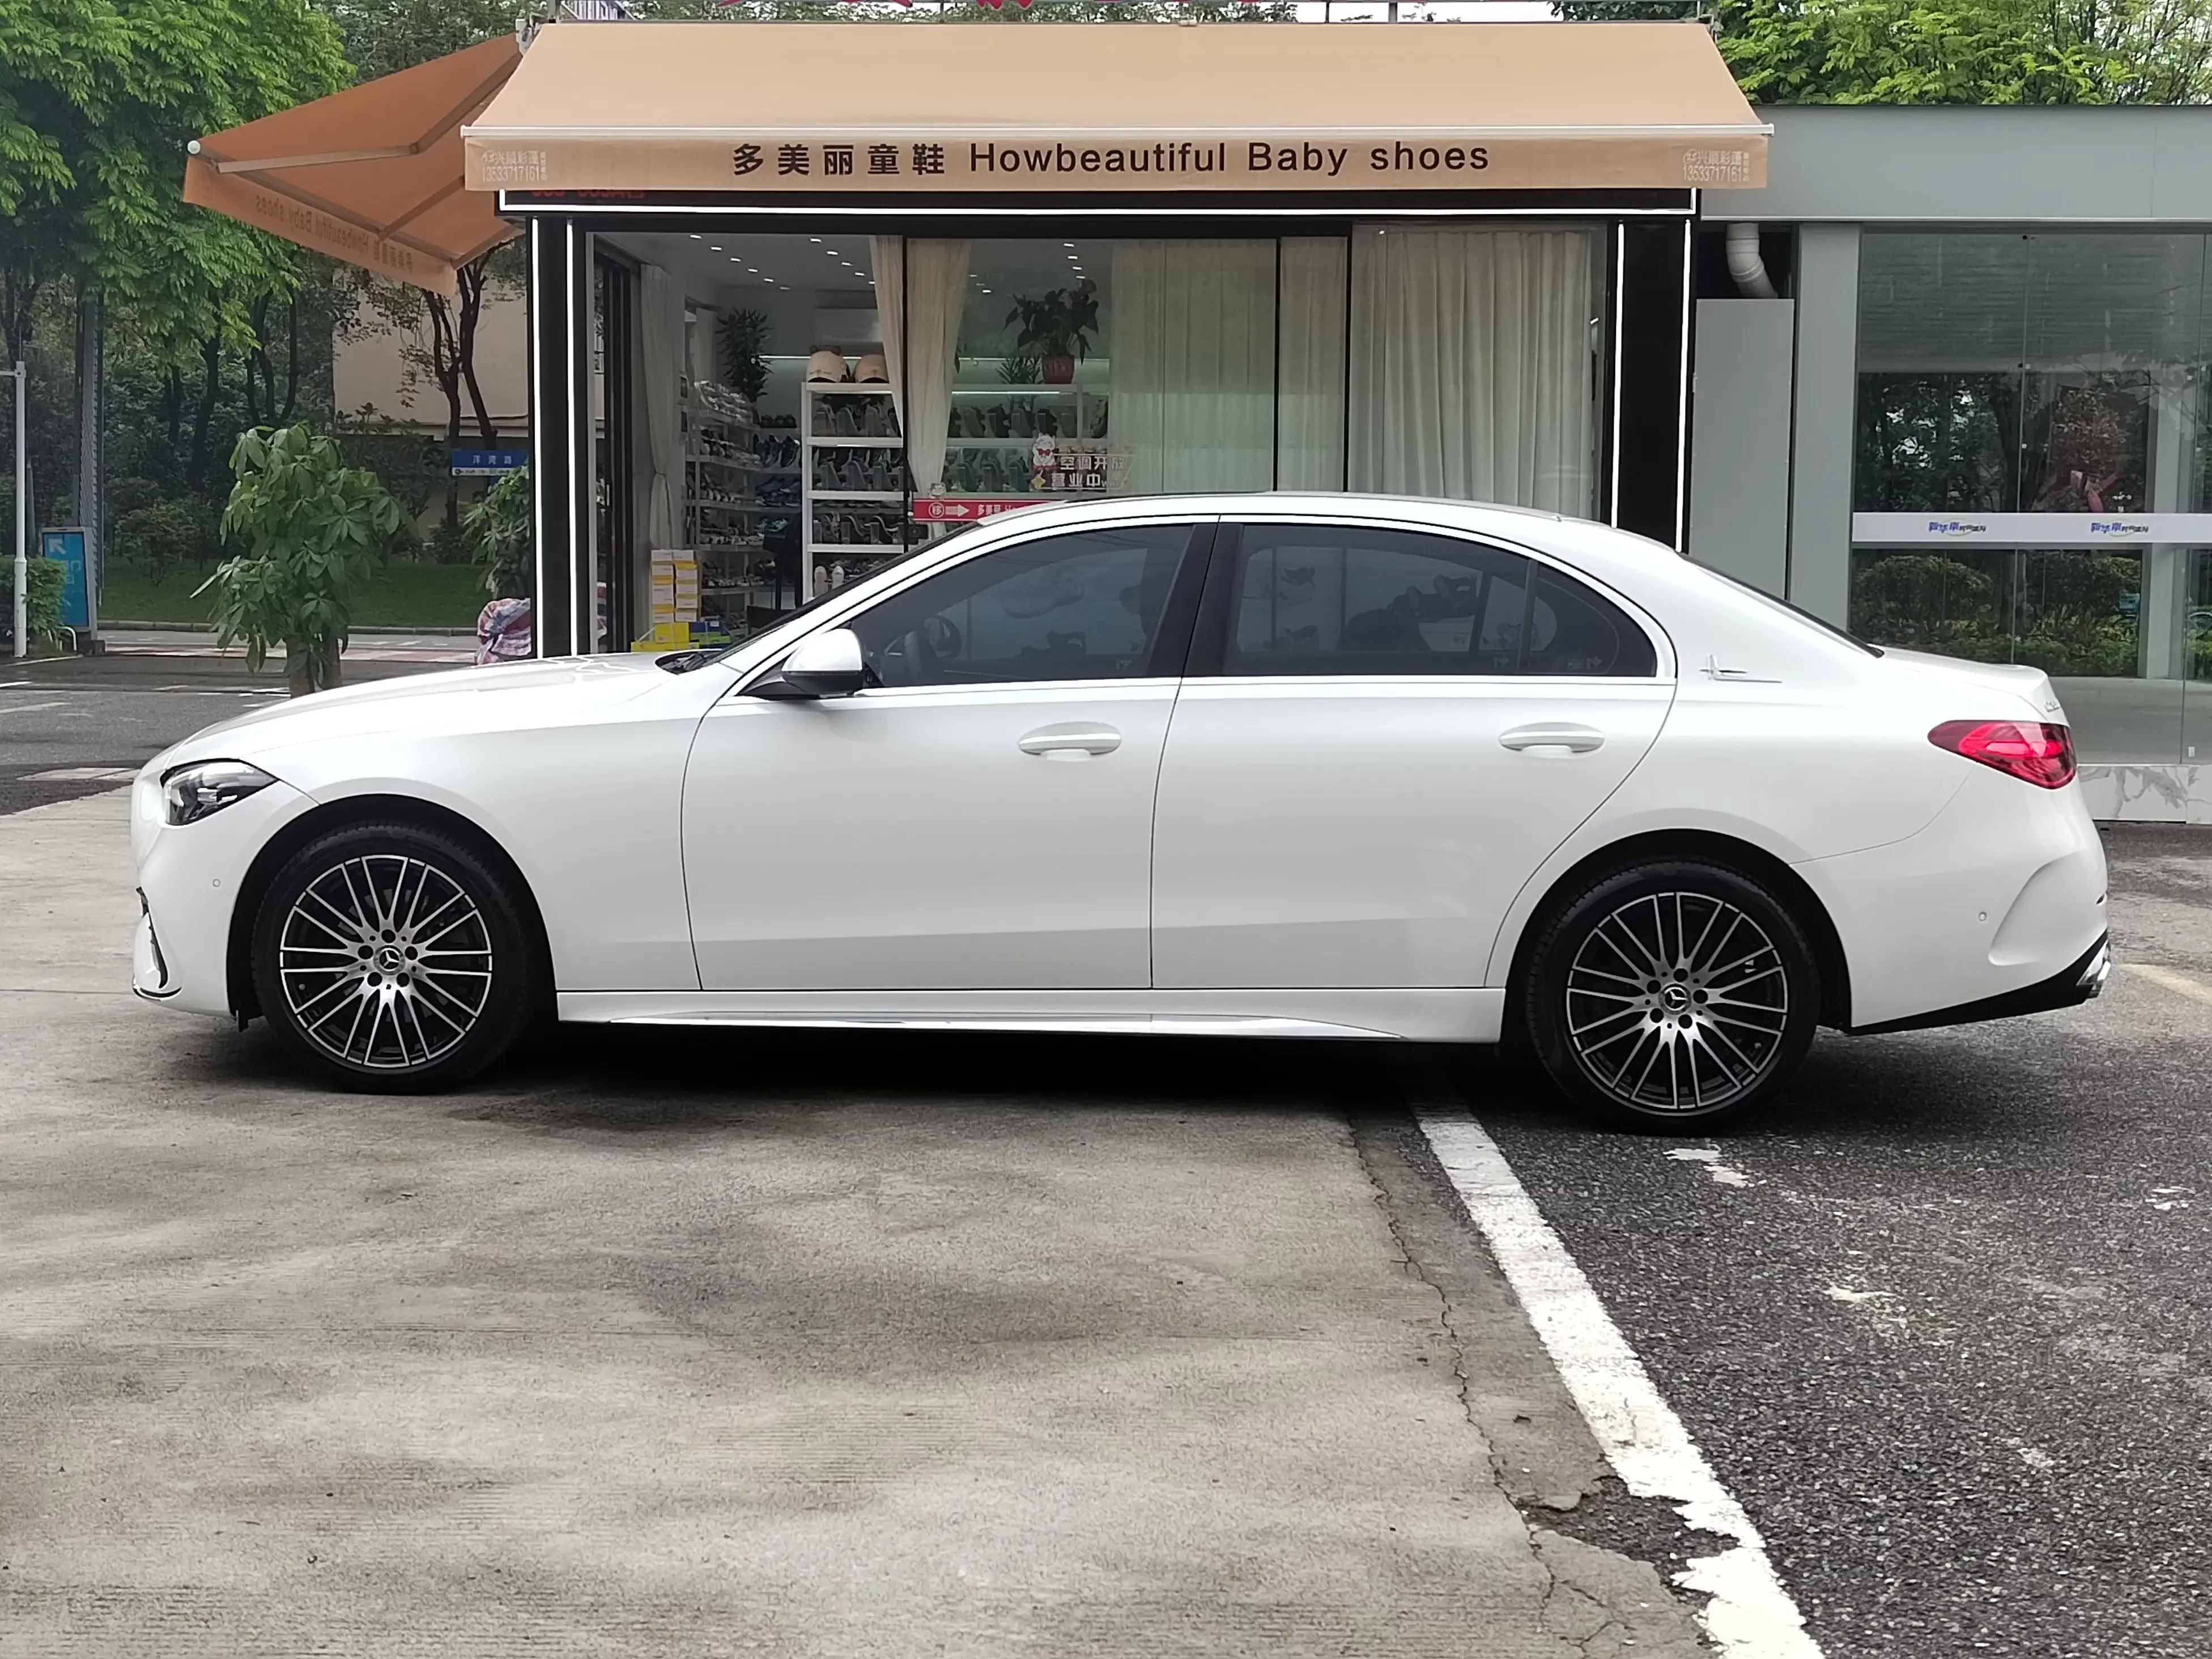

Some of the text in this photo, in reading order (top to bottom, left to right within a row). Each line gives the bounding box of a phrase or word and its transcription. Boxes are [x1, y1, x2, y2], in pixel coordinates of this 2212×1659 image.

[734, 141, 1488, 177] 多美丽童鞋 Howbeautiful Baby shoes
[482, 165, 539, 182] 13533717161
[1683, 164, 1741, 182] 13533717161
[1060, 456, 1125, 470] 空调开放
[1051, 473, 1101, 487] 营业中
